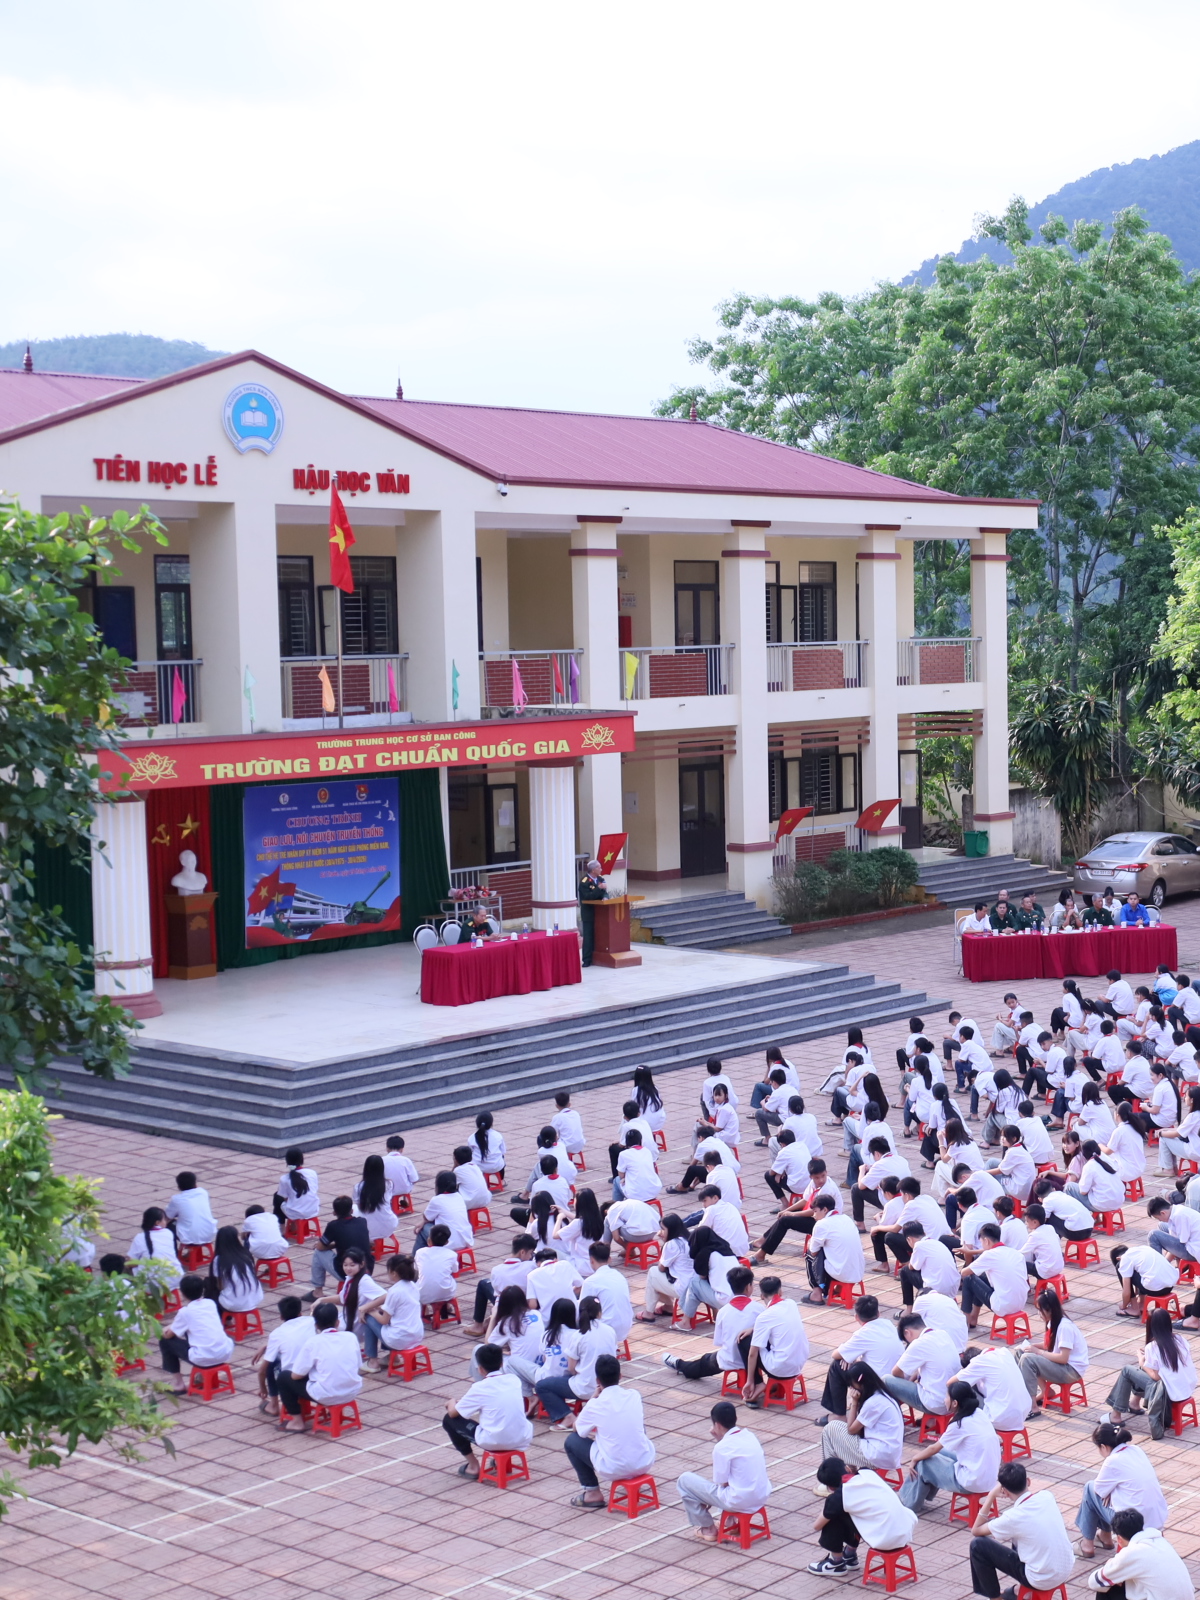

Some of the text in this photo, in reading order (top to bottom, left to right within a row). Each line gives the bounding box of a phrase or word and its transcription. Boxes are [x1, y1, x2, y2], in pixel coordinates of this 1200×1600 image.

[93, 454, 218, 490] TIÊN HỌC LỄ
[293, 464, 410, 497] HẬU HỌC VĂN
[316, 731, 476, 749] TRƯỜNG TRUNG HỌC CƠ SỞ BAN CÔNG
[200, 739, 570, 780] TRƯỜNG ĐẠT CHUẨN QUỐC GIA
[262, 836, 279, 847] GIAO
[296, 831, 308, 844] NÓI
